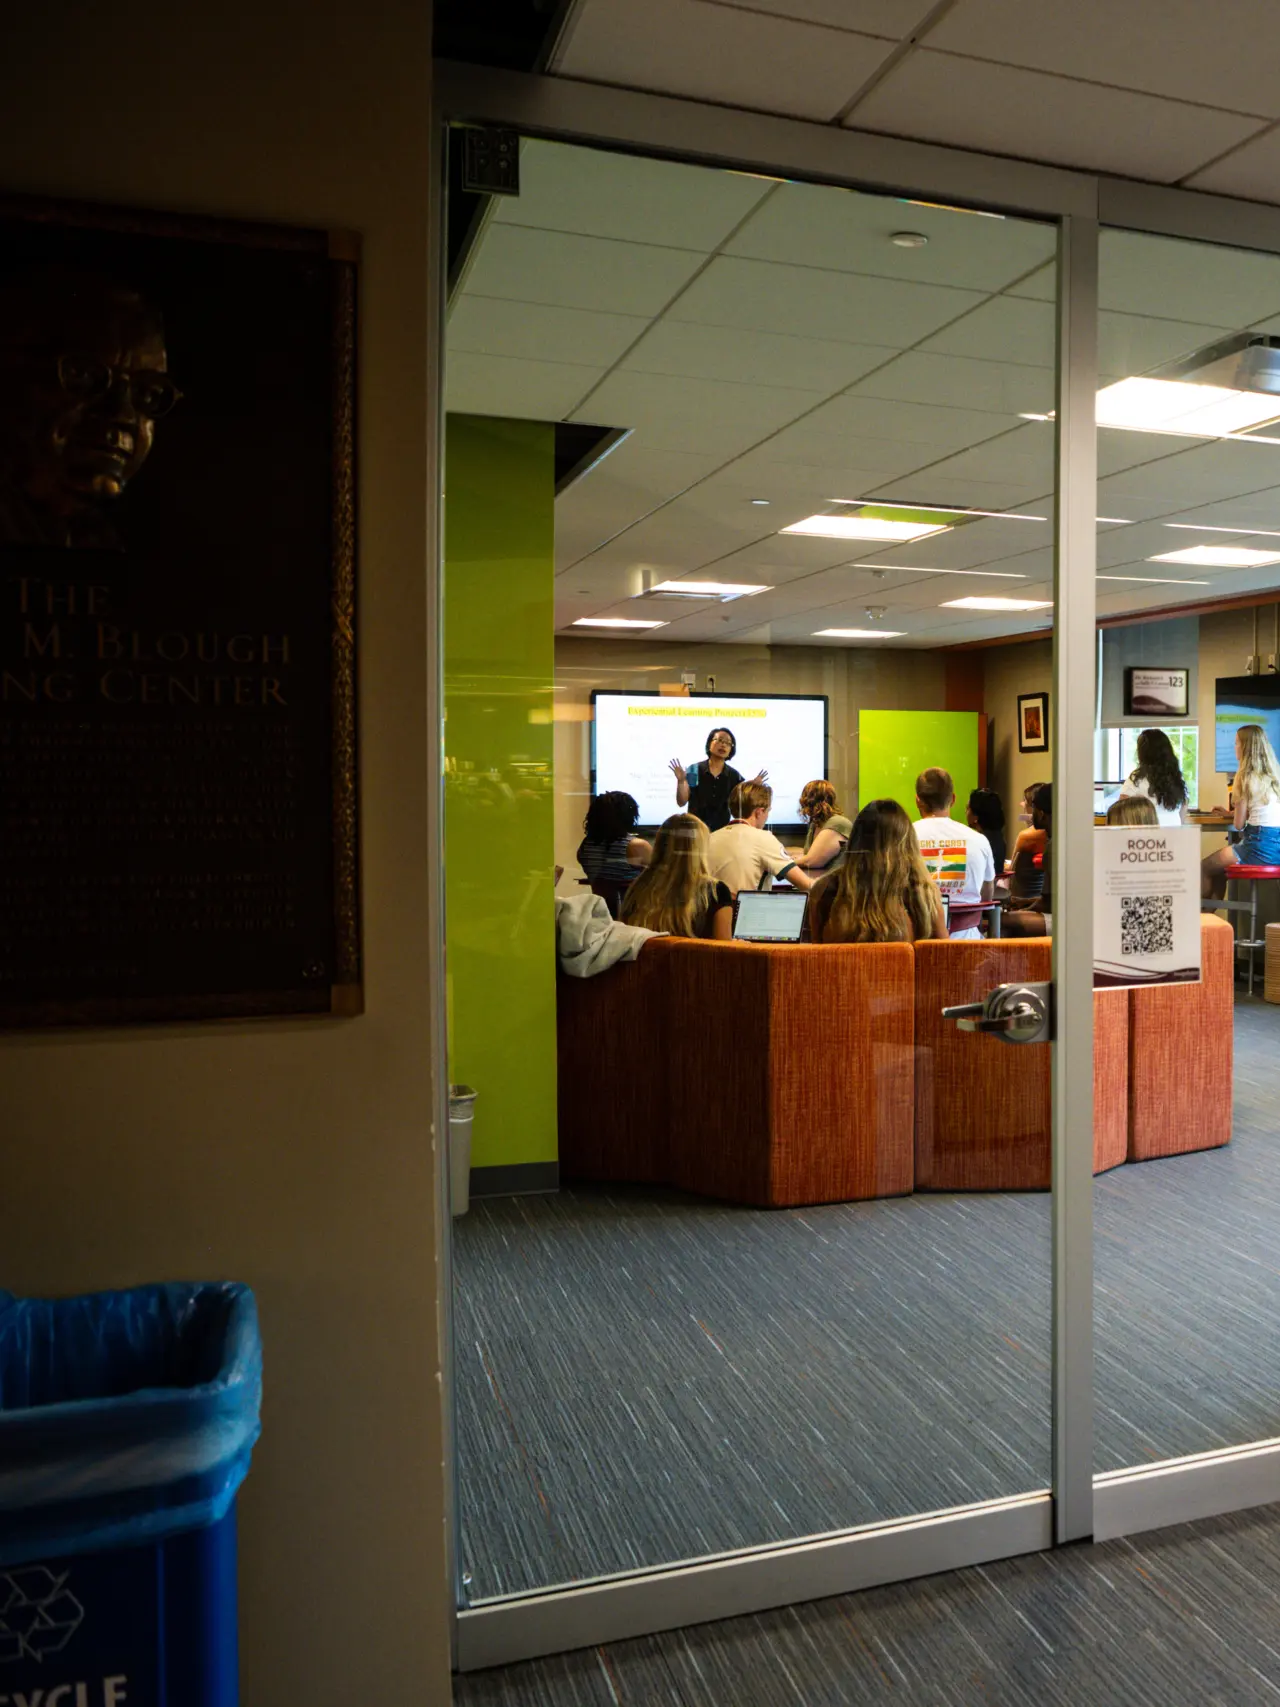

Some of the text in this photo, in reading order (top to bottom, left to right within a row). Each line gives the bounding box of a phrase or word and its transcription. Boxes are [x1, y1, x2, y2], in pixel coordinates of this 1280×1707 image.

[7, 577, 110, 615] THE
[97, 621, 290, 665] BLOUGH
[1, 667, 288, 706] NG CENTER
[1168, 676, 1184, 688] 123
[1120, 851, 1174, 863] POLICIES
[1128, 839, 1167, 850] ROOM
